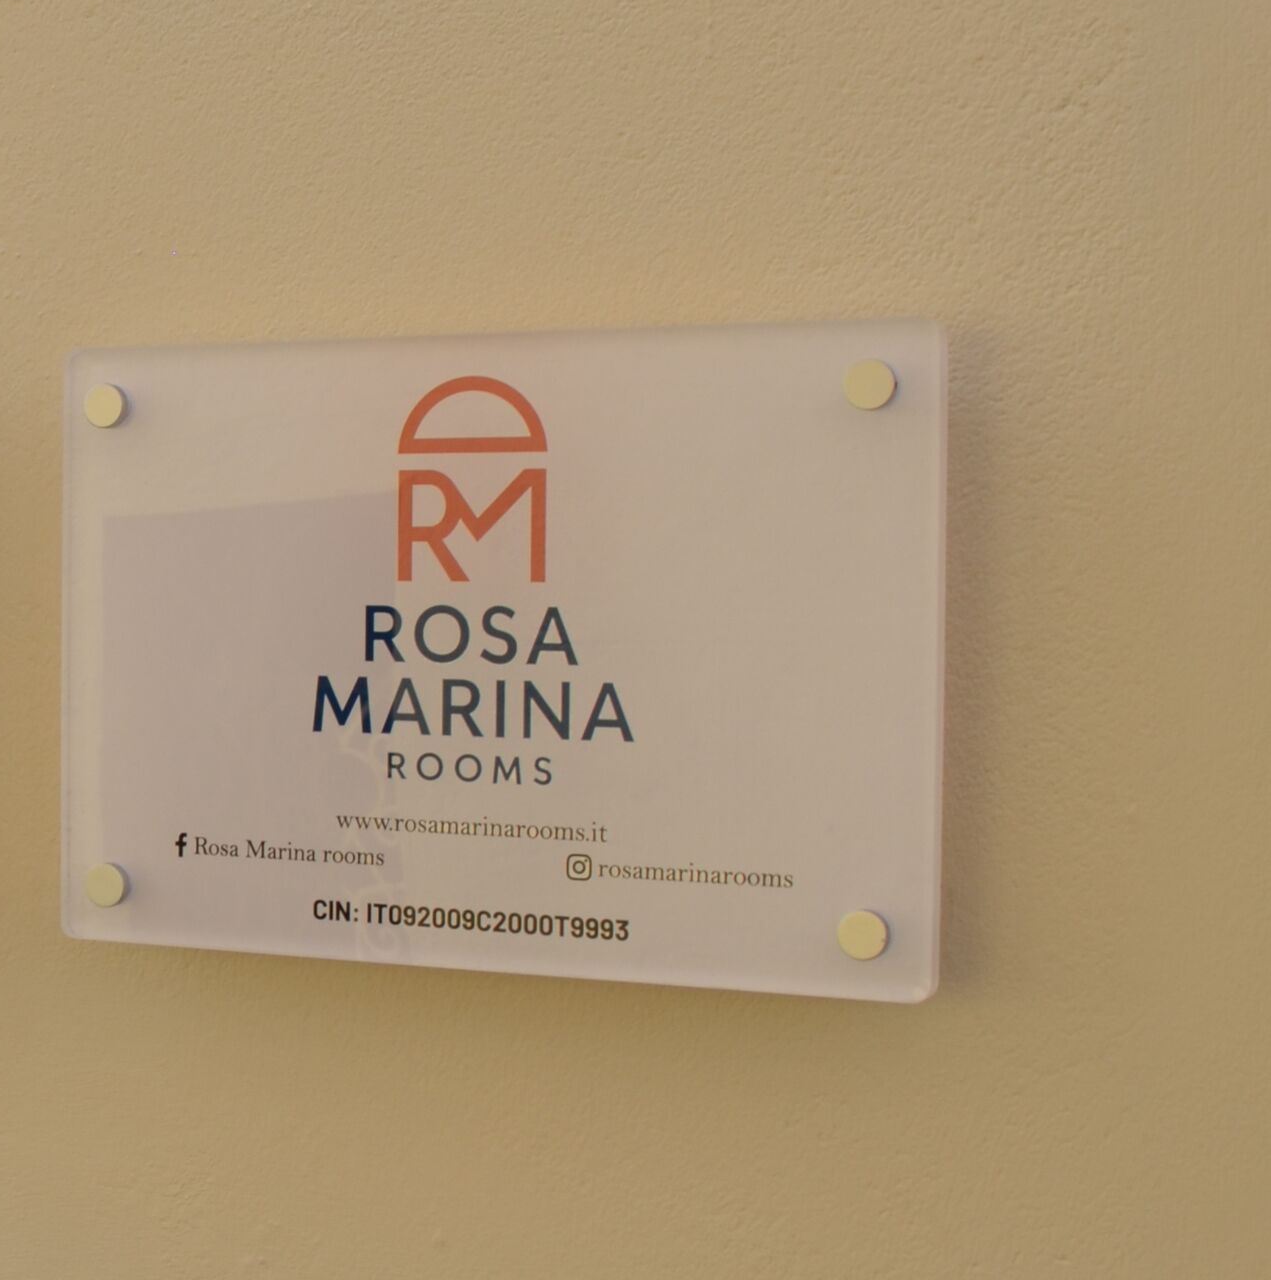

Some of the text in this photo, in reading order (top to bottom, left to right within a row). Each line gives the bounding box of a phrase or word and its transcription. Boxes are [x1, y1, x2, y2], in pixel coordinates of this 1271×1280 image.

[397, 468, 547, 583] RM
[363, 604, 578, 666] ROSA
[312, 675, 634, 742] MARINA
[386, 751, 553, 786] ROOMS
[335, 814, 608, 844] www.rosamarinarooms.it
[193, 835, 240, 857] Rosa
[245, 838, 316, 863] Marina
[322, 849, 385, 867] rooms
[597, 861, 794, 889] rosamarinarooms
[312, 898, 630, 942] CIN: IT092009C2000T9993
